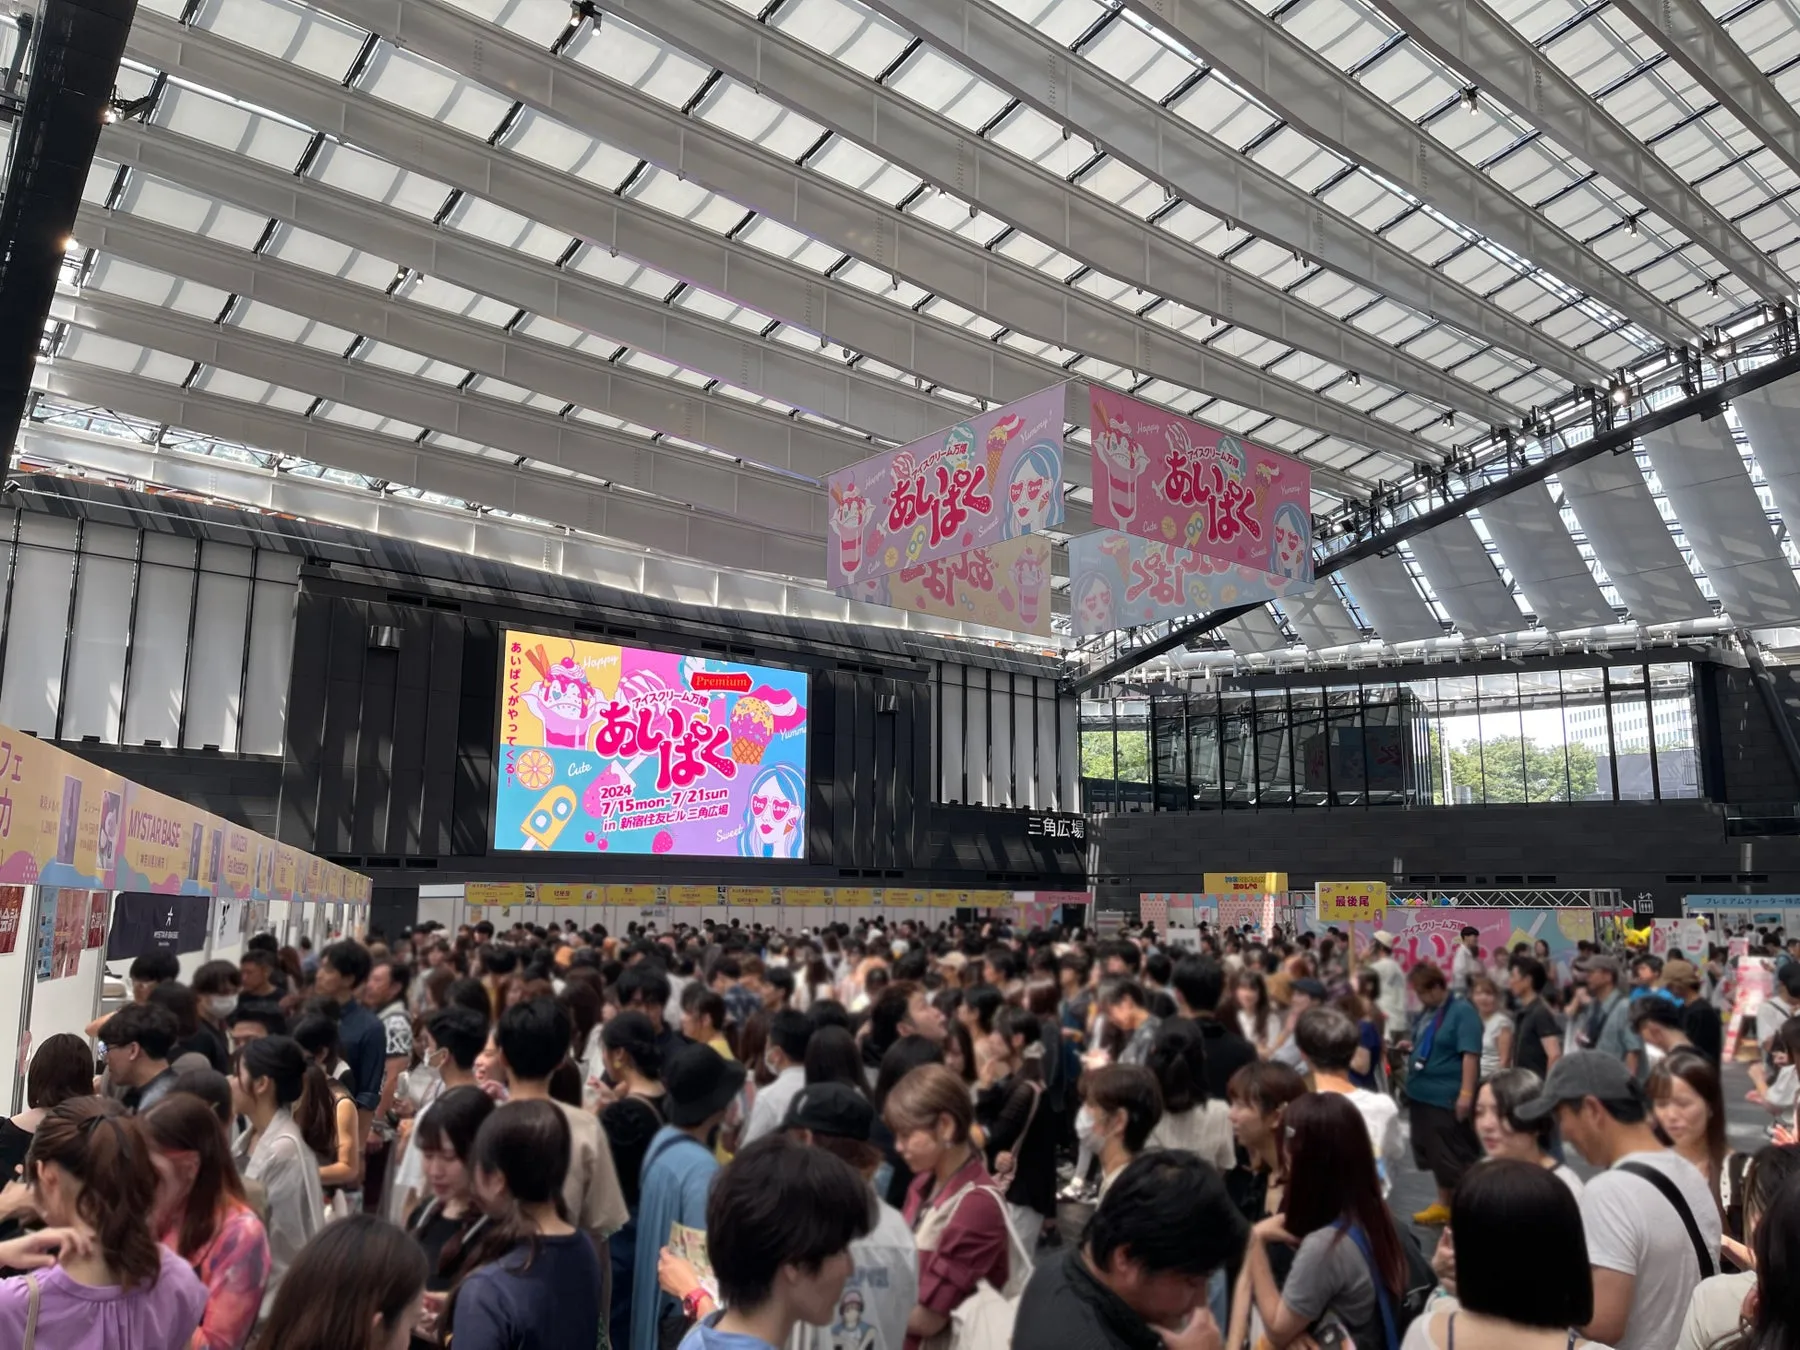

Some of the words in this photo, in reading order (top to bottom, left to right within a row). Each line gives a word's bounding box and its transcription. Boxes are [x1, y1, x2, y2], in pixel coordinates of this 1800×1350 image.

[583, 655, 619, 673] Happy
[696, 675, 748, 688] Premium
[631, 690, 709, 708] アイスクリーム万博
[567, 763, 593, 777] Cute
[600, 784, 632, 799] 2024
[603, 821, 616, 831] in
[716, 824, 743, 842] Sweet
[1028, 817, 1085, 839] 三角広場
[1335, 895, 1370, 907] 最後尾
